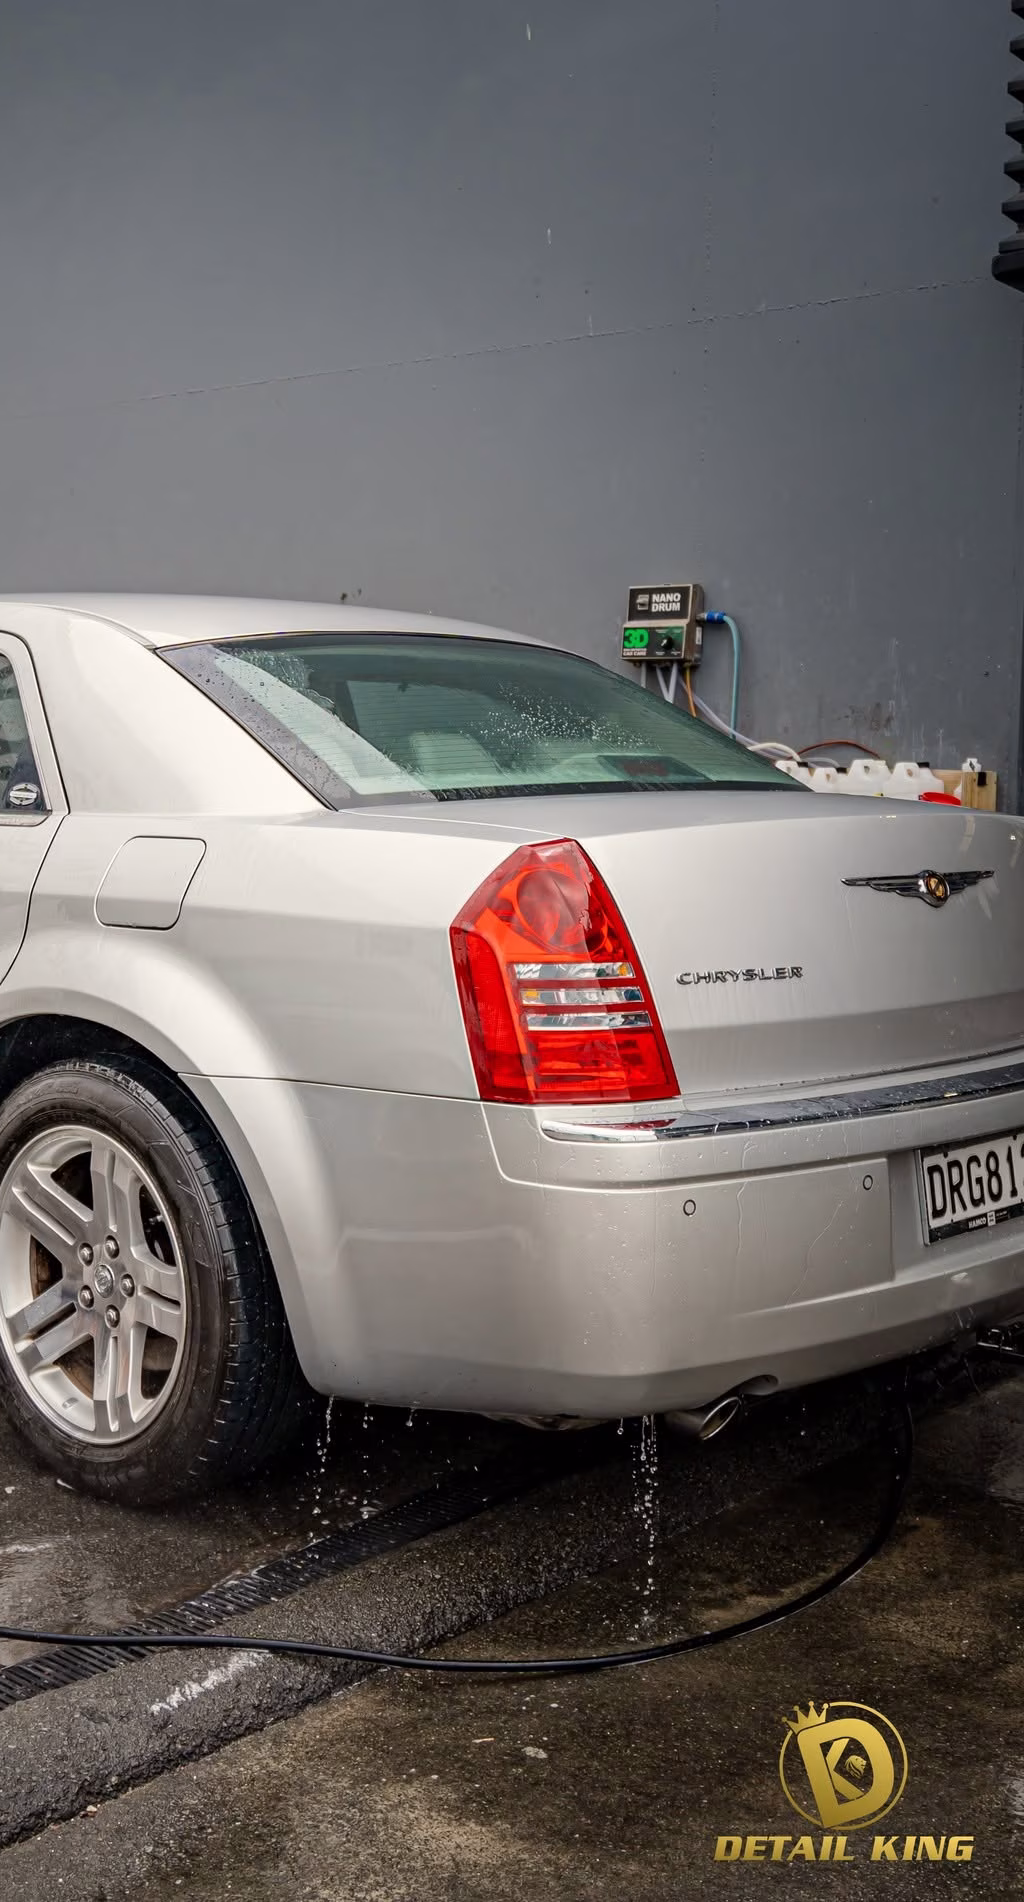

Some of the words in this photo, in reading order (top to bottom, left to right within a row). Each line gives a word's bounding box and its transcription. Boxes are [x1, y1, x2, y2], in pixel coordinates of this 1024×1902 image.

[652, 592, 682, 603] NANO
[651, 602, 681, 613] DRUM
[623, 629, 649, 648] 3D
[676, 966, 803, 985] CHRYSLER
[927, 1143, 1024, 1219] DRG81
